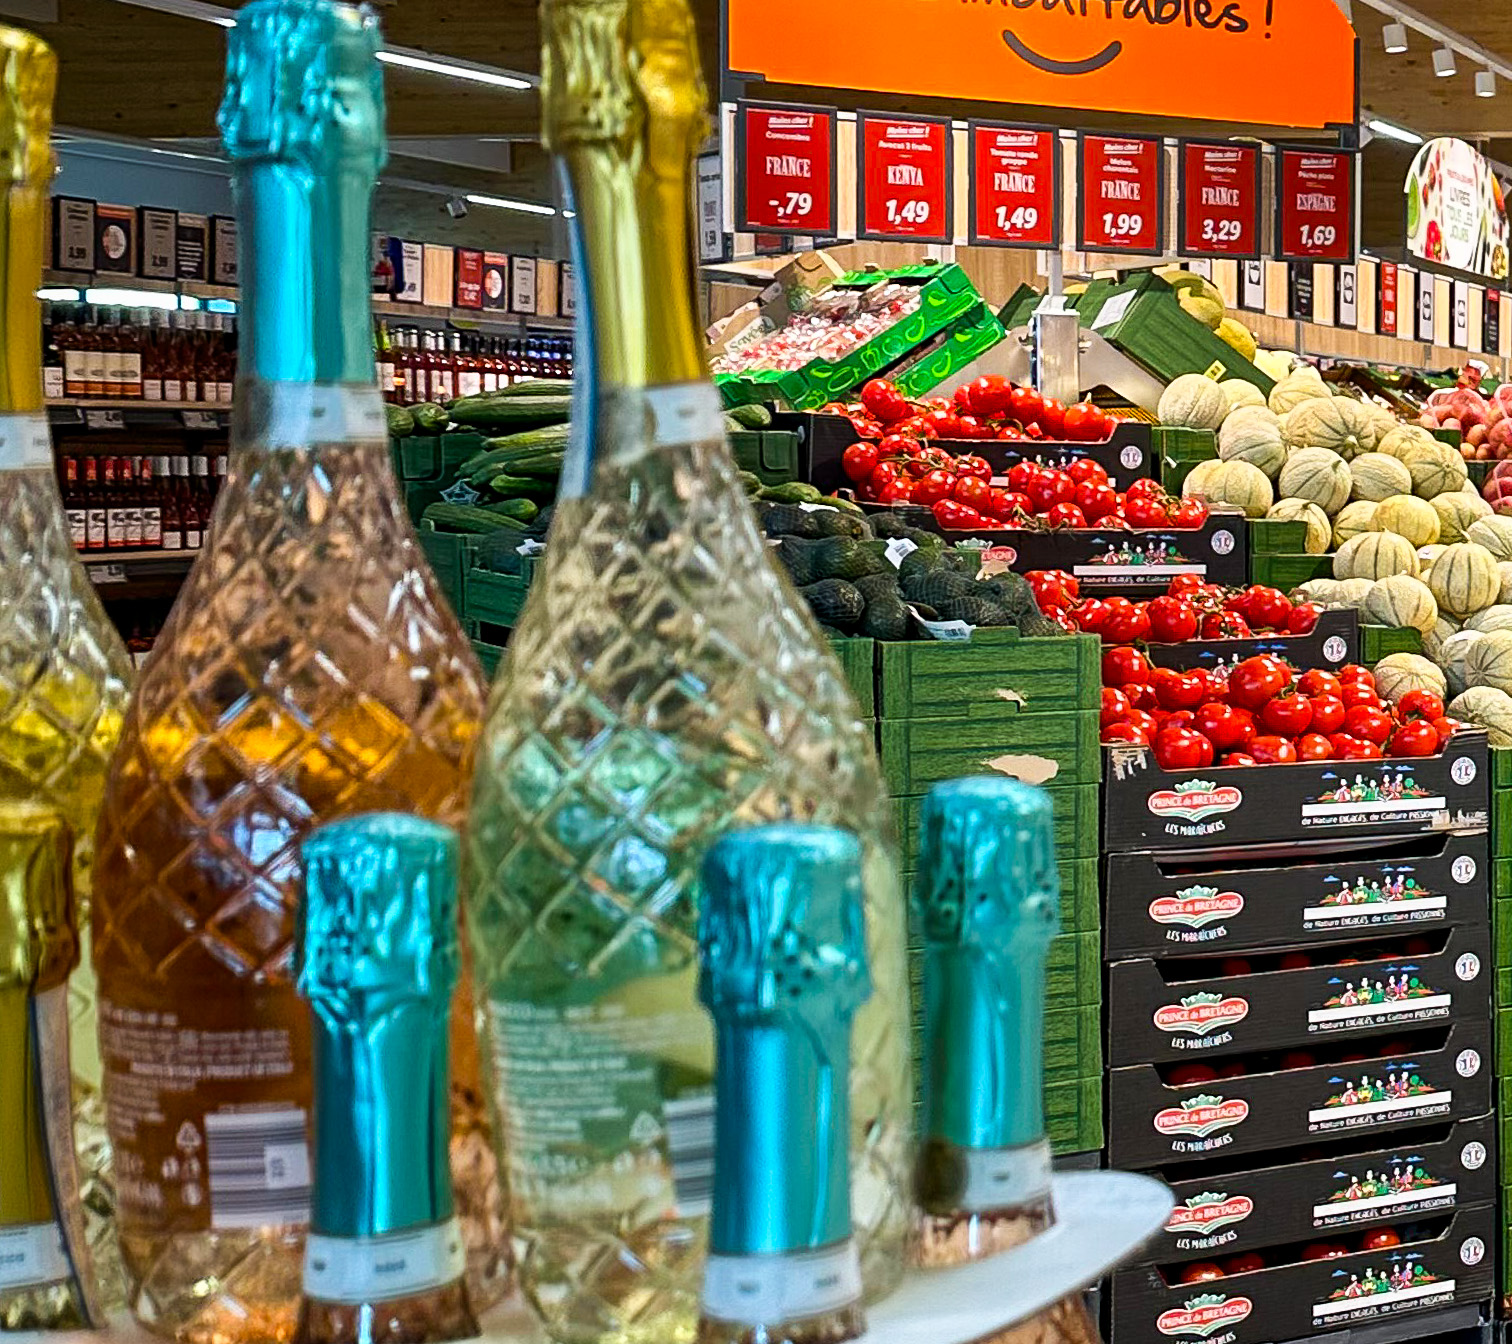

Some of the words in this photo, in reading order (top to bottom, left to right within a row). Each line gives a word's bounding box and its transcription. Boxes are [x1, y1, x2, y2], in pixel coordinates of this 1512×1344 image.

[765, 155, 811, 178] FRANCE
[887, 164, 924, 187] KENYA
[994, 172, 1036, 194] FRANCE
[1101, 179, 1141, 201] FRANCE
[768, 192, 813, 217] -,79
[1201, 186, 1240, 207] FRANCE
[1296, 193, 1336, 212] ESPAGNE
[886, 199, 930, 224] 1,49
[995, 206, 1038, 231] 1,49
[1102, 212, 1143, 237] 1,99
[1201, 218, 1242, 242] 3,29
[1300, 224, 1336, 248] 1,69
[1153, 797, 1182, 807] PRINCE
[1192, 793, 1236, 805] BRETAGNE
[1164, 823, 1179, 835] LES
[1154, 903, 1184, 914] PRINCE
[1194, 899, 1239, 911] BRETAGNE
[1166, 929, 1180, 942] LES
[1158, 1011, 1189, 1022] PRINCE
[1199, 1004, 1244, 1018] BRETAGNE
[1171, 1037, 1185, 1049] LES
[1158, 1114, 1190, 1126] PRINCE
[1200, 1106, 1244, 1120] BRETAGNE
[1171, 1140, 1186, 1152] LES
[1204, 1202, 1248, 1218] BRETAGNE
[1176, 1238, 1190, 1249] LES
[1161, 1314, 1193, 1327] PRINCE
[1203, 1303, 1248, 1320] BRETAGNE
